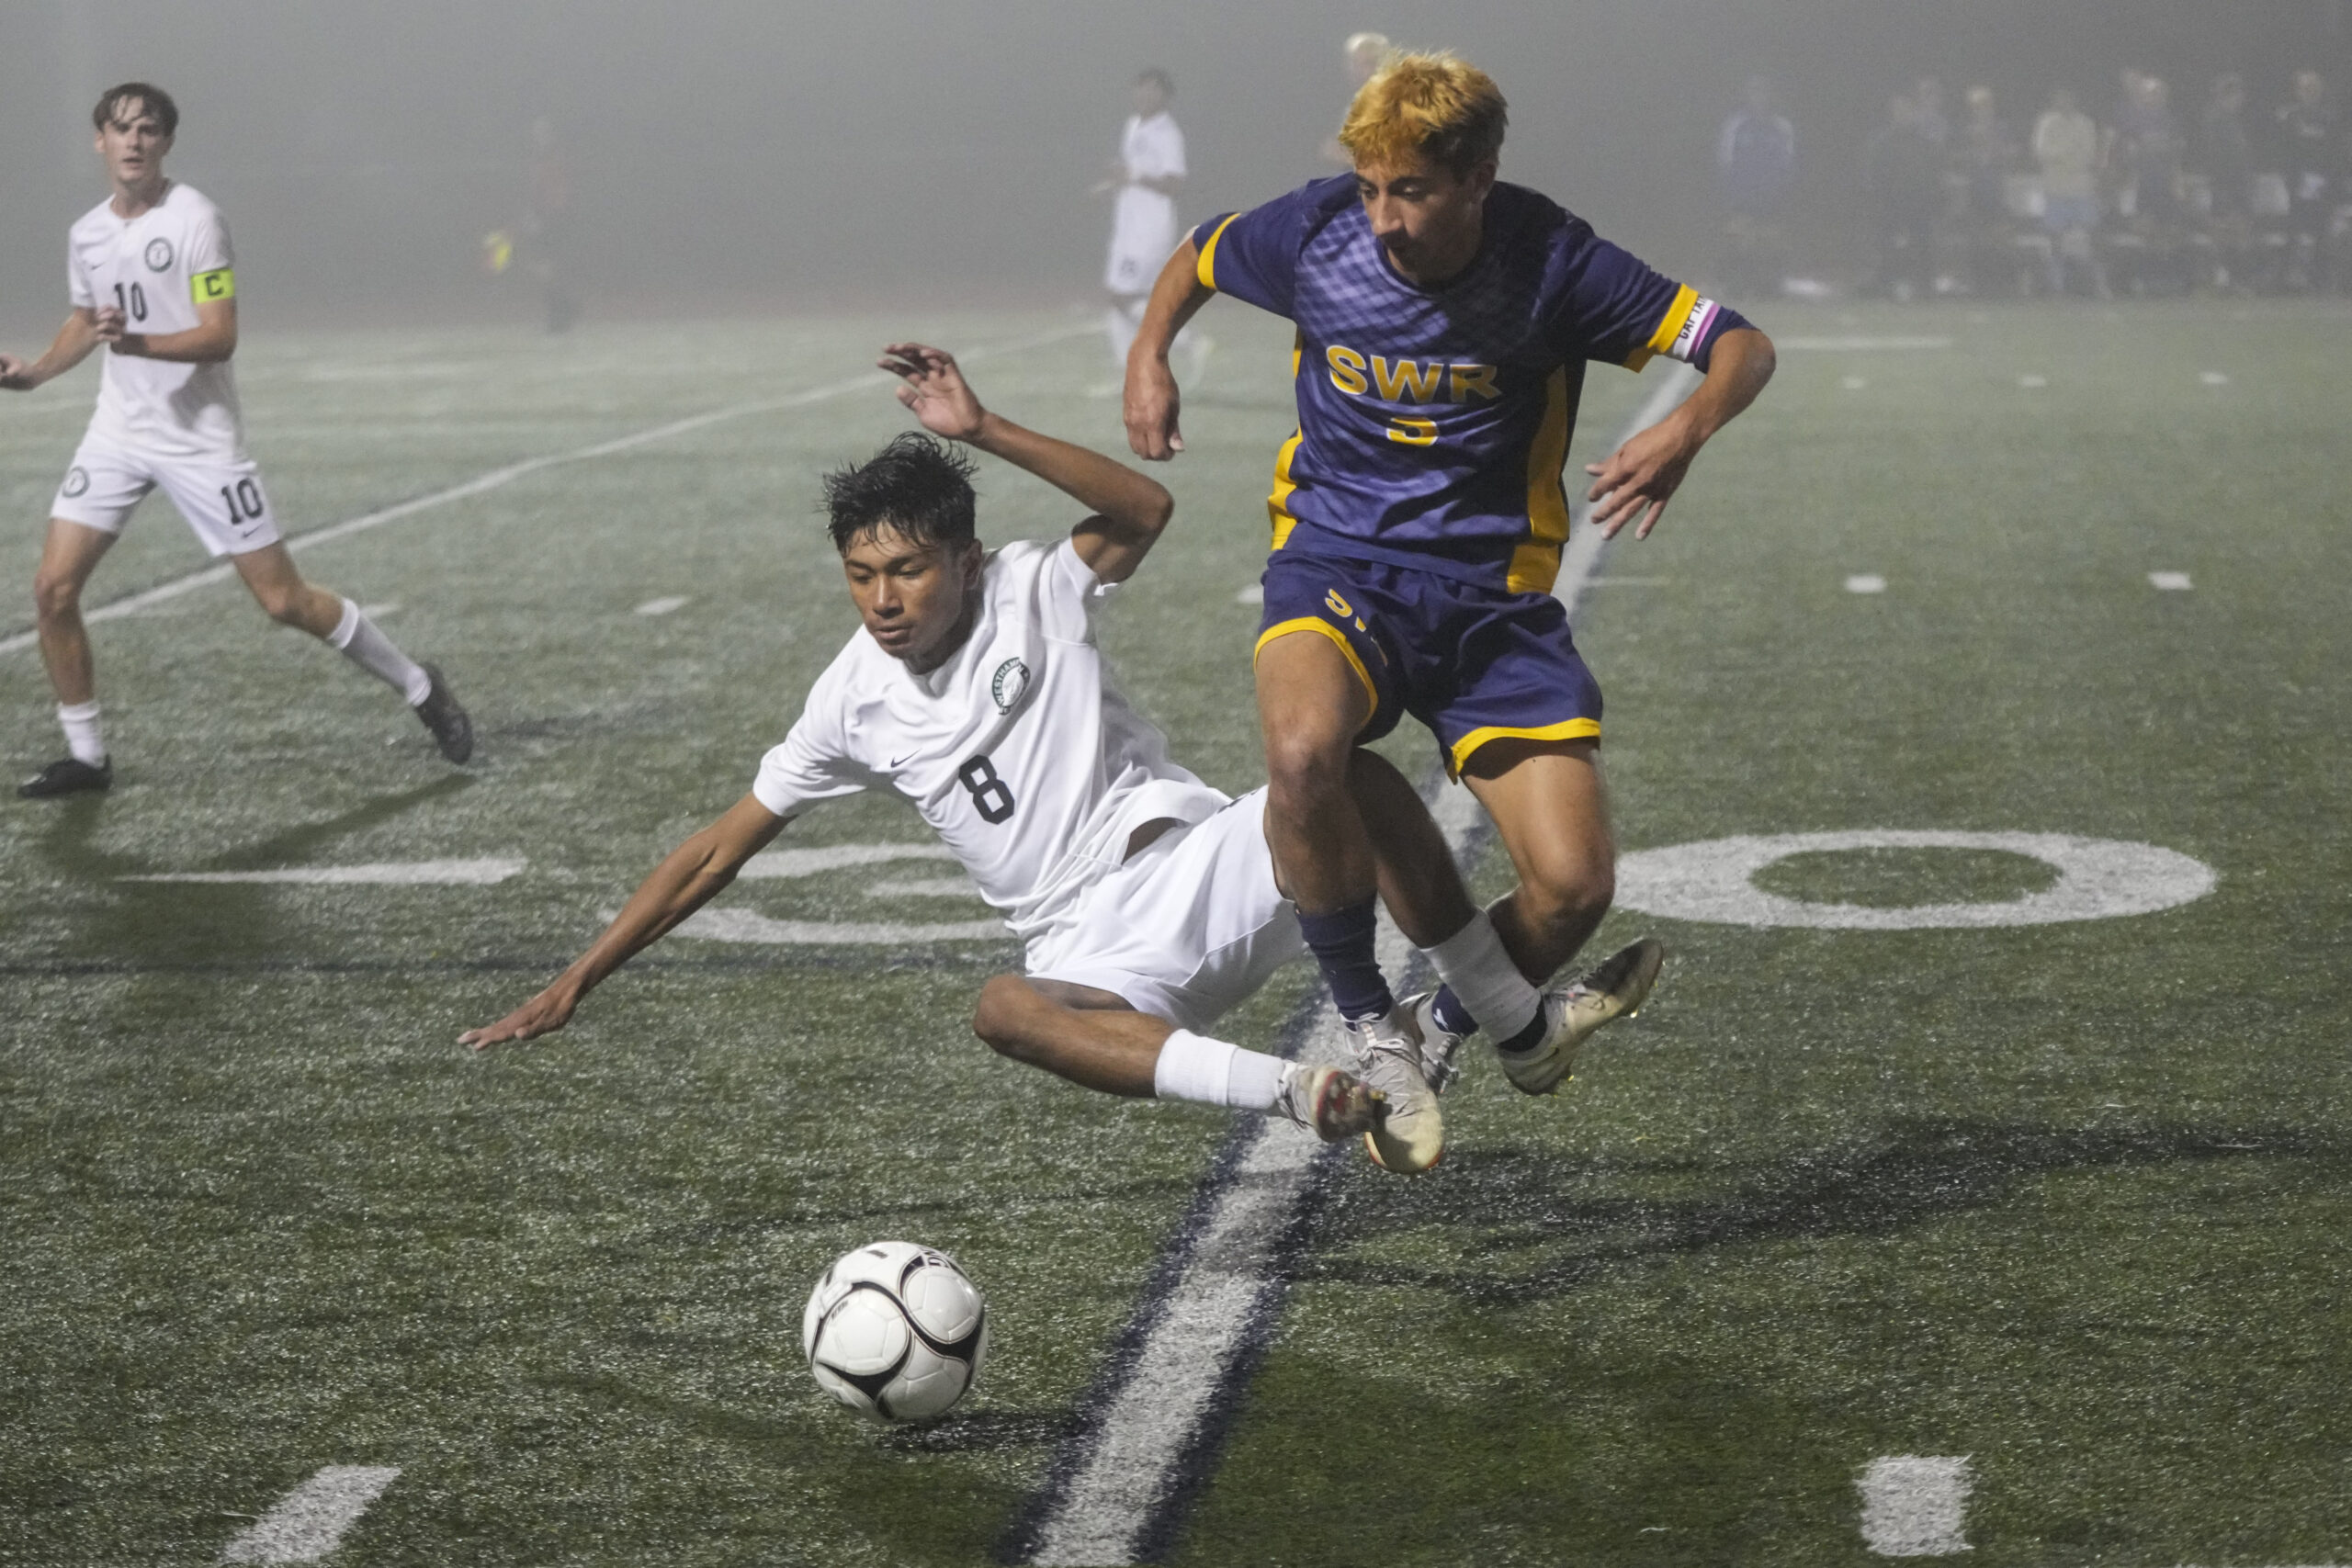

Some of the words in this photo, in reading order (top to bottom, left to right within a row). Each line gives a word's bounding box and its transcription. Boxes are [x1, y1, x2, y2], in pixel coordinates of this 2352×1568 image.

[114, 281, 148, 322] 10
[204, 275, 225, 296] C
[1326, 344, 1503, 403] SWR
[221, 477, 265, 525] 10
[958, 754, 1015, 825] 8
